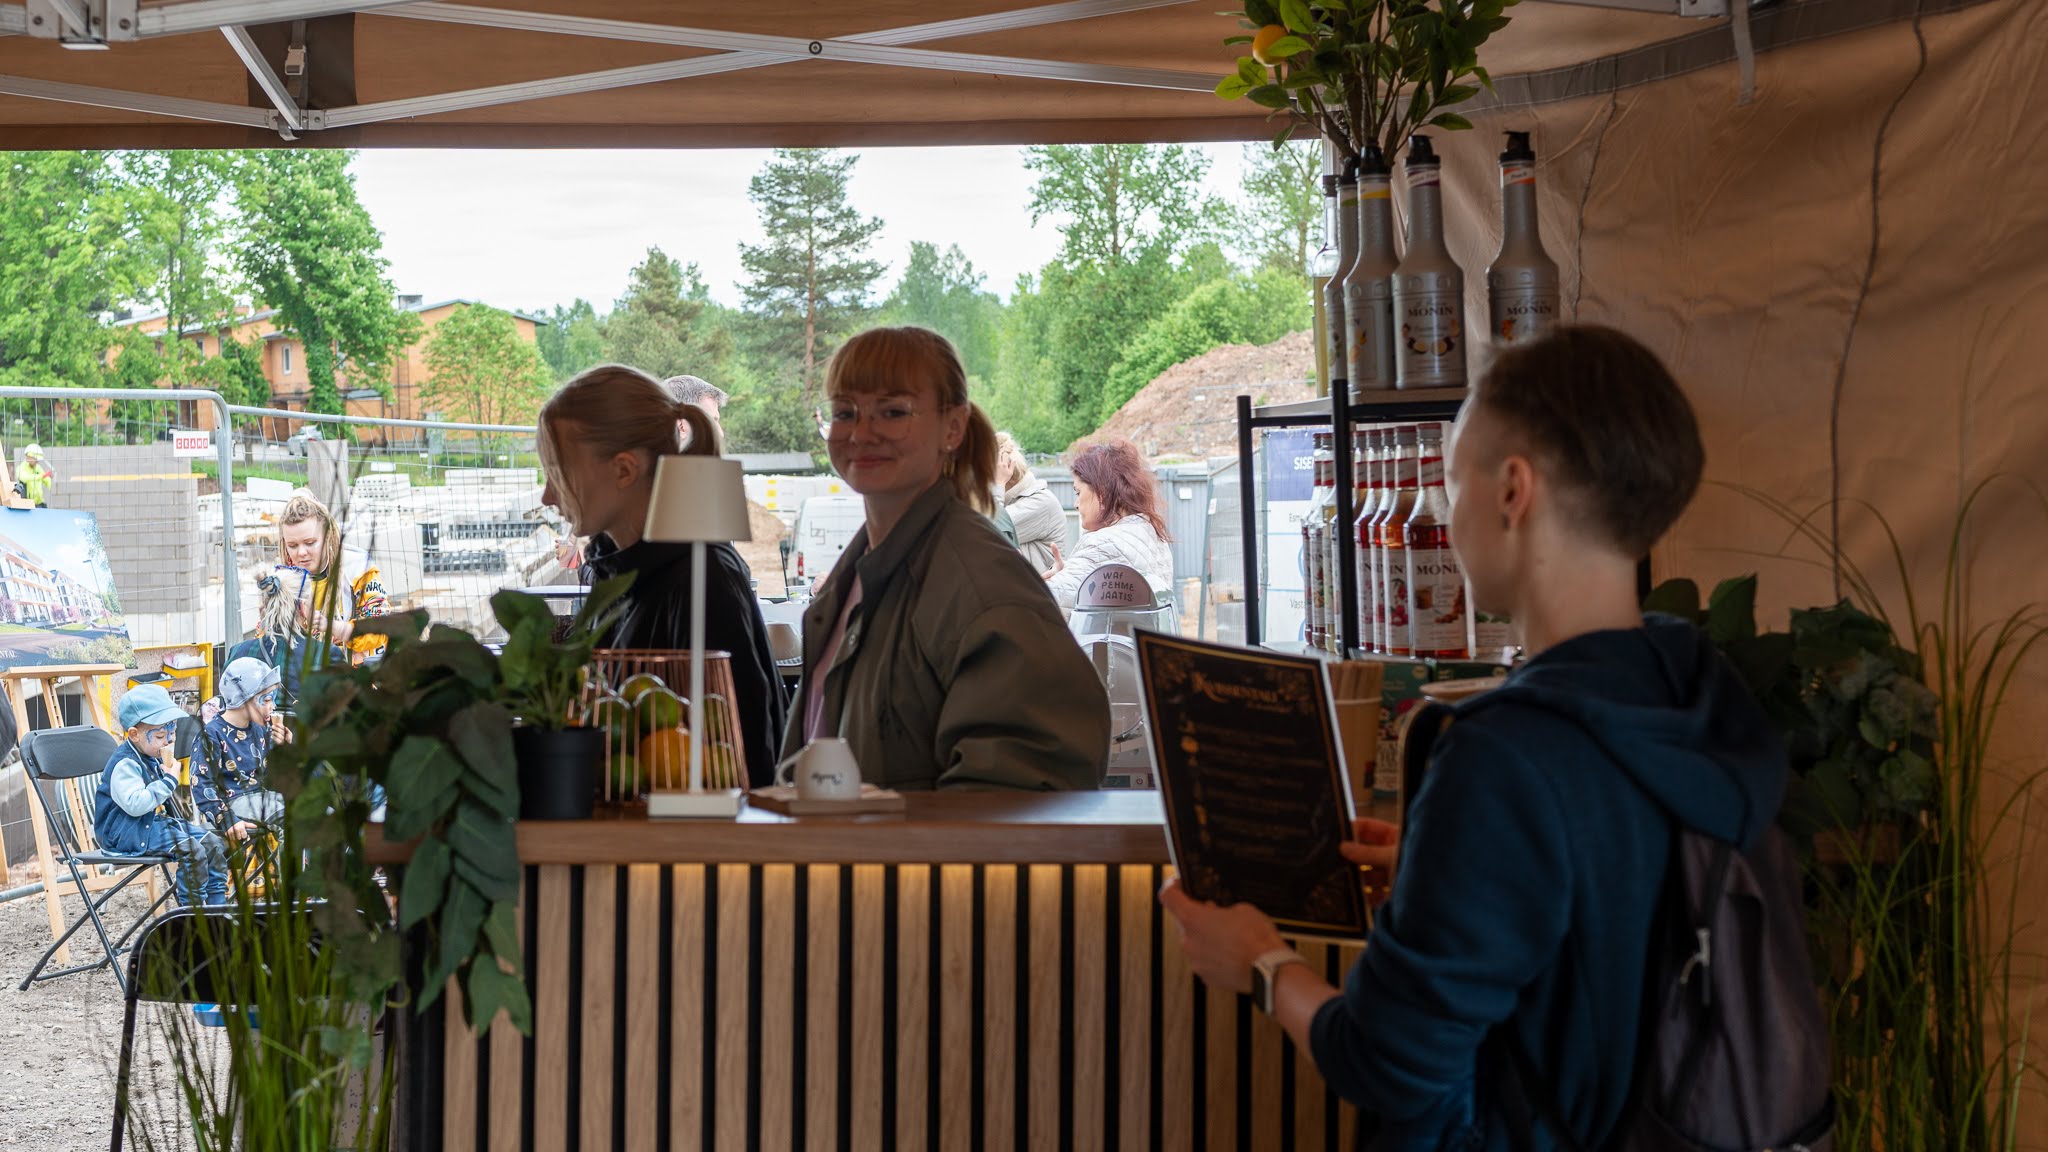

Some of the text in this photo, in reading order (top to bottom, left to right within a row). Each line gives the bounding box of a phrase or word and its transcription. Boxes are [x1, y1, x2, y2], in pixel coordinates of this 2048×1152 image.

[1408, 306, 1453, 317] MONIN
[1507, 304, 1552, 316] MONIN
[176, 438, 208, 449] CRAMO
[1416, 564, 1461, 576] MONI
[1102, 581, 1134, 592] PEHME
